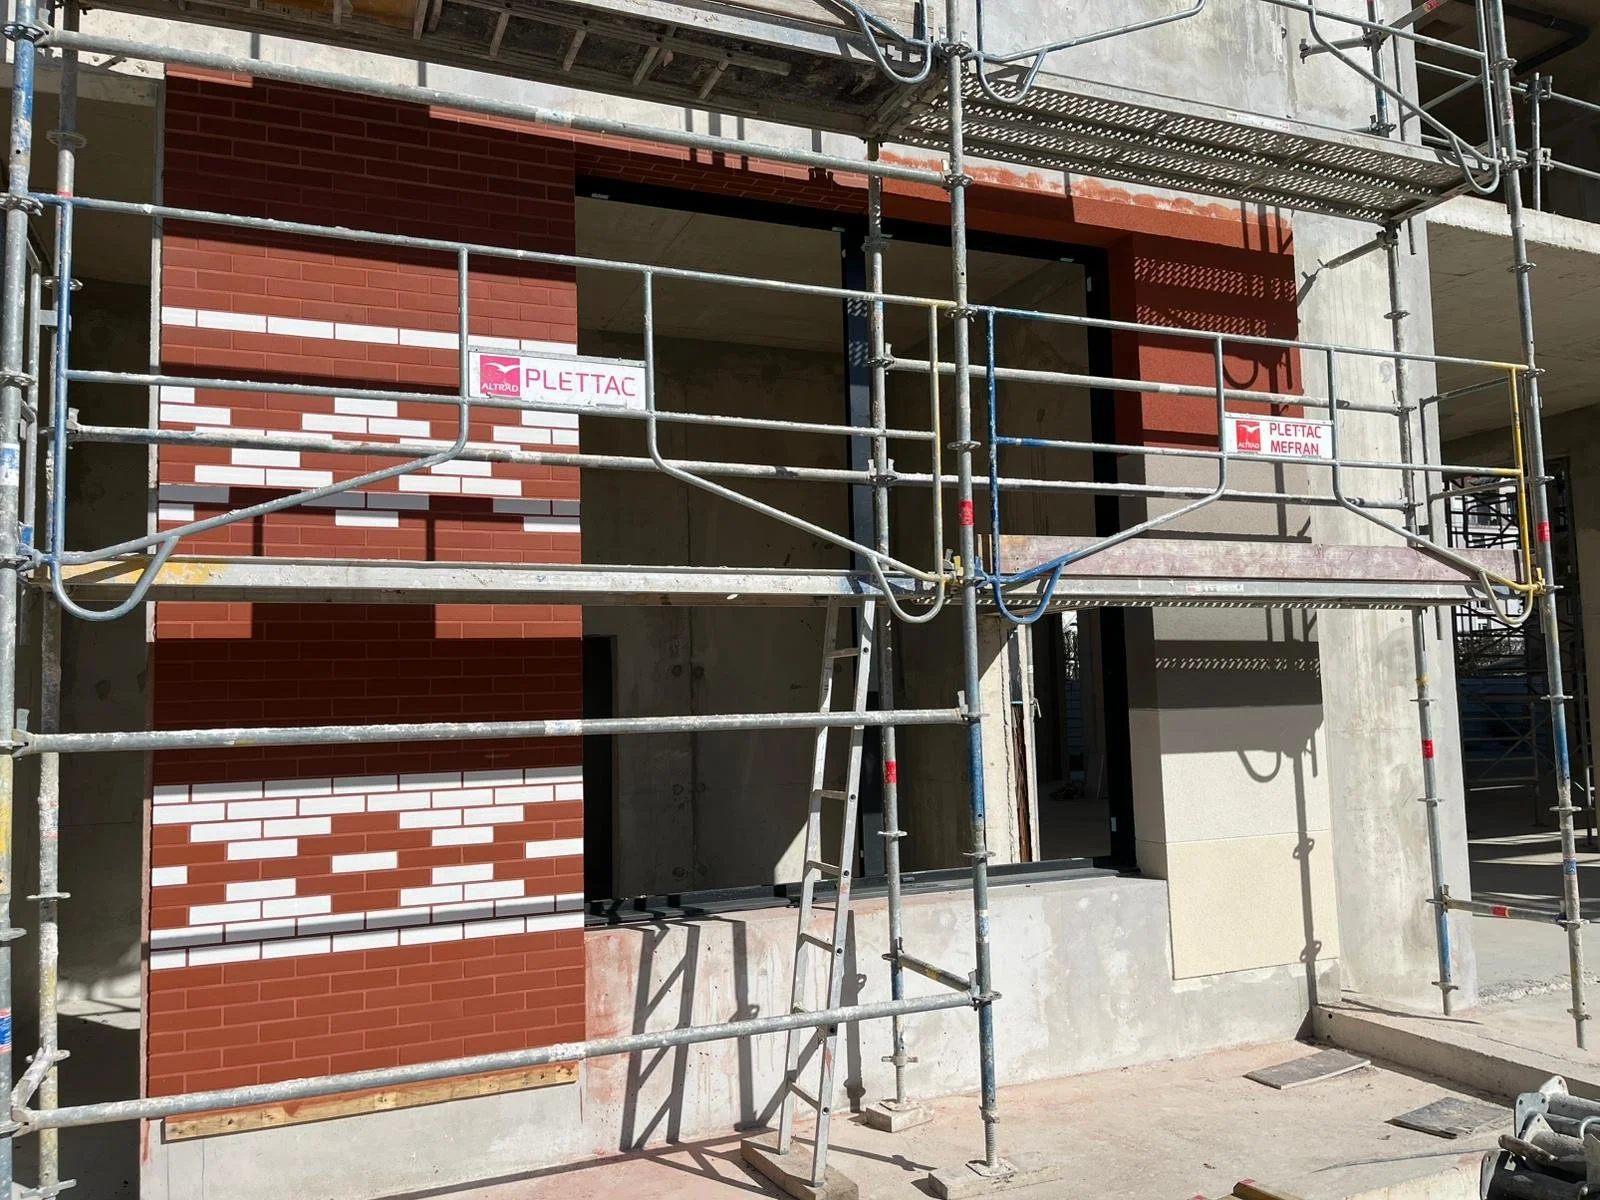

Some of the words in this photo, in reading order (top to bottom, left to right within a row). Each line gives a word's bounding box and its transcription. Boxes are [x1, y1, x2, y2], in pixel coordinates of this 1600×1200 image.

[482, 382, 519, 392] ALTRAD
[525, 368, 636, 397] PLETTAC
[1269, 422, 1321, 438] PLETTAC
[1270, 440, 1319, 455] MEFRAN
